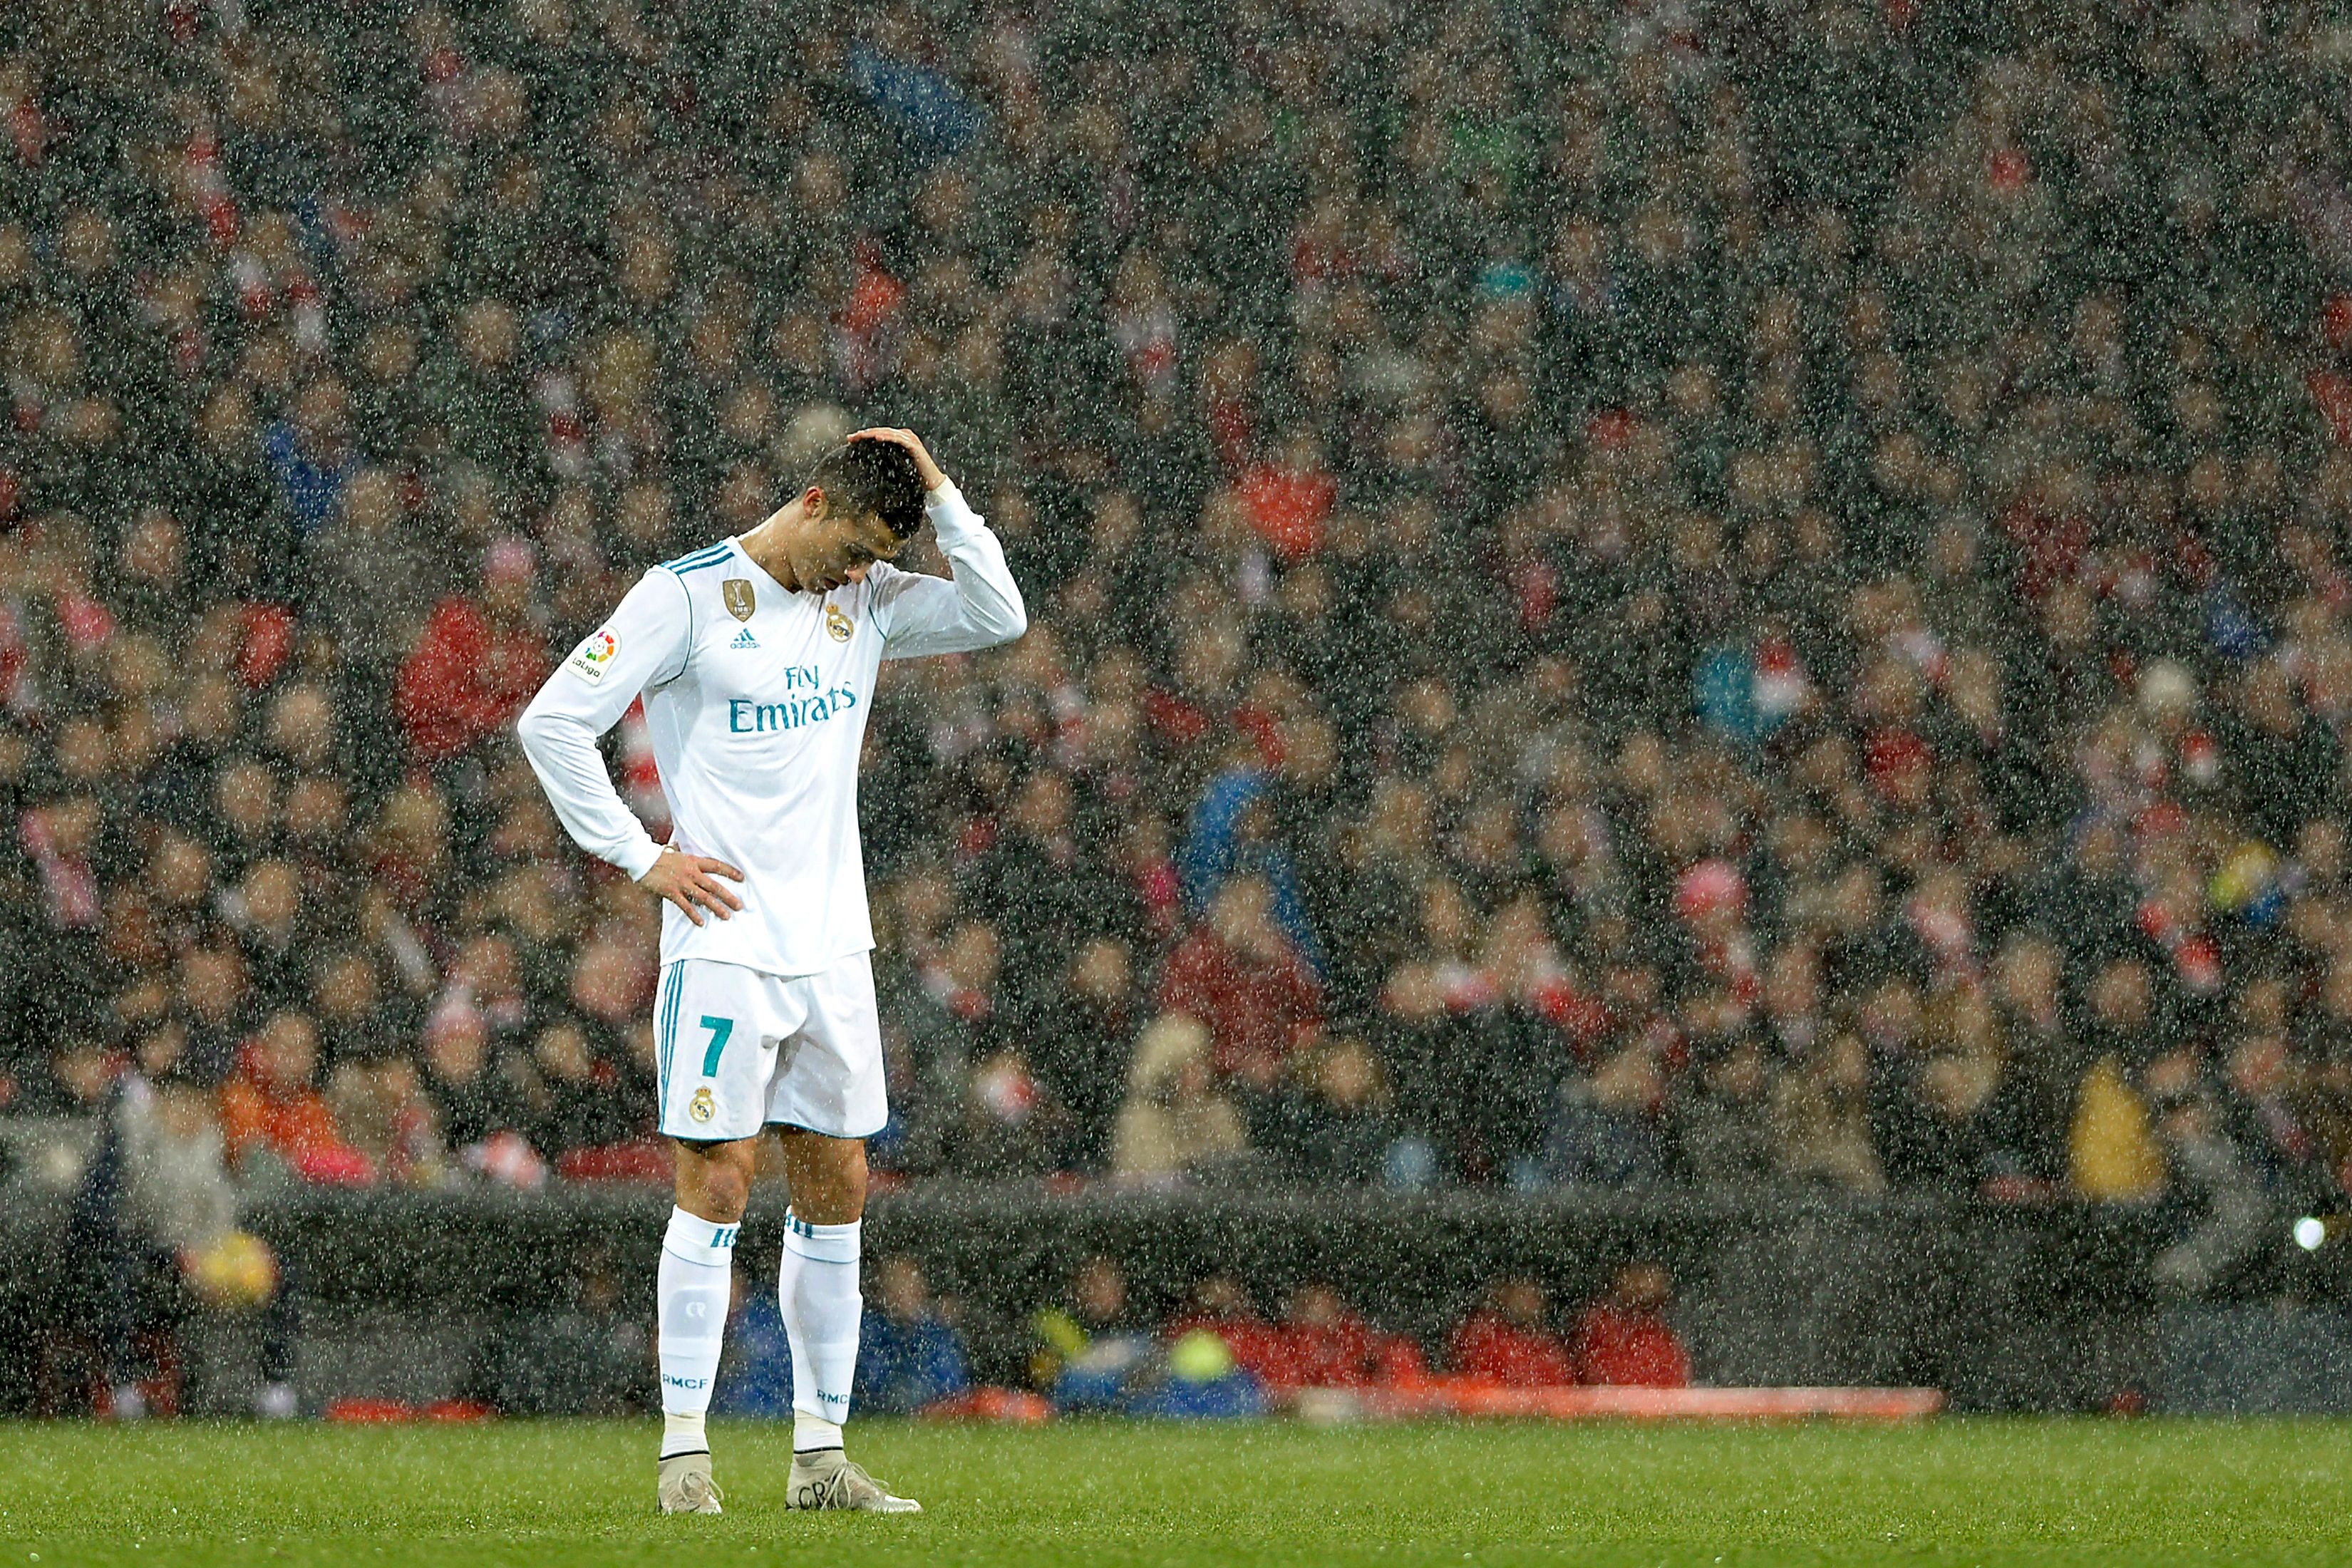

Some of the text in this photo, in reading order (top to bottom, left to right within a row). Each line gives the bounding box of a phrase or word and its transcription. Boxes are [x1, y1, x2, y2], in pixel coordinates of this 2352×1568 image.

[784, 665, 819, 690] Fly
[728, 681, 856, 733] Emirats
[700, 1015, 733, 1078] 7
[662, 1373, 708, 1389] RMCF
[817, 1388, 848, 1404] RMC
